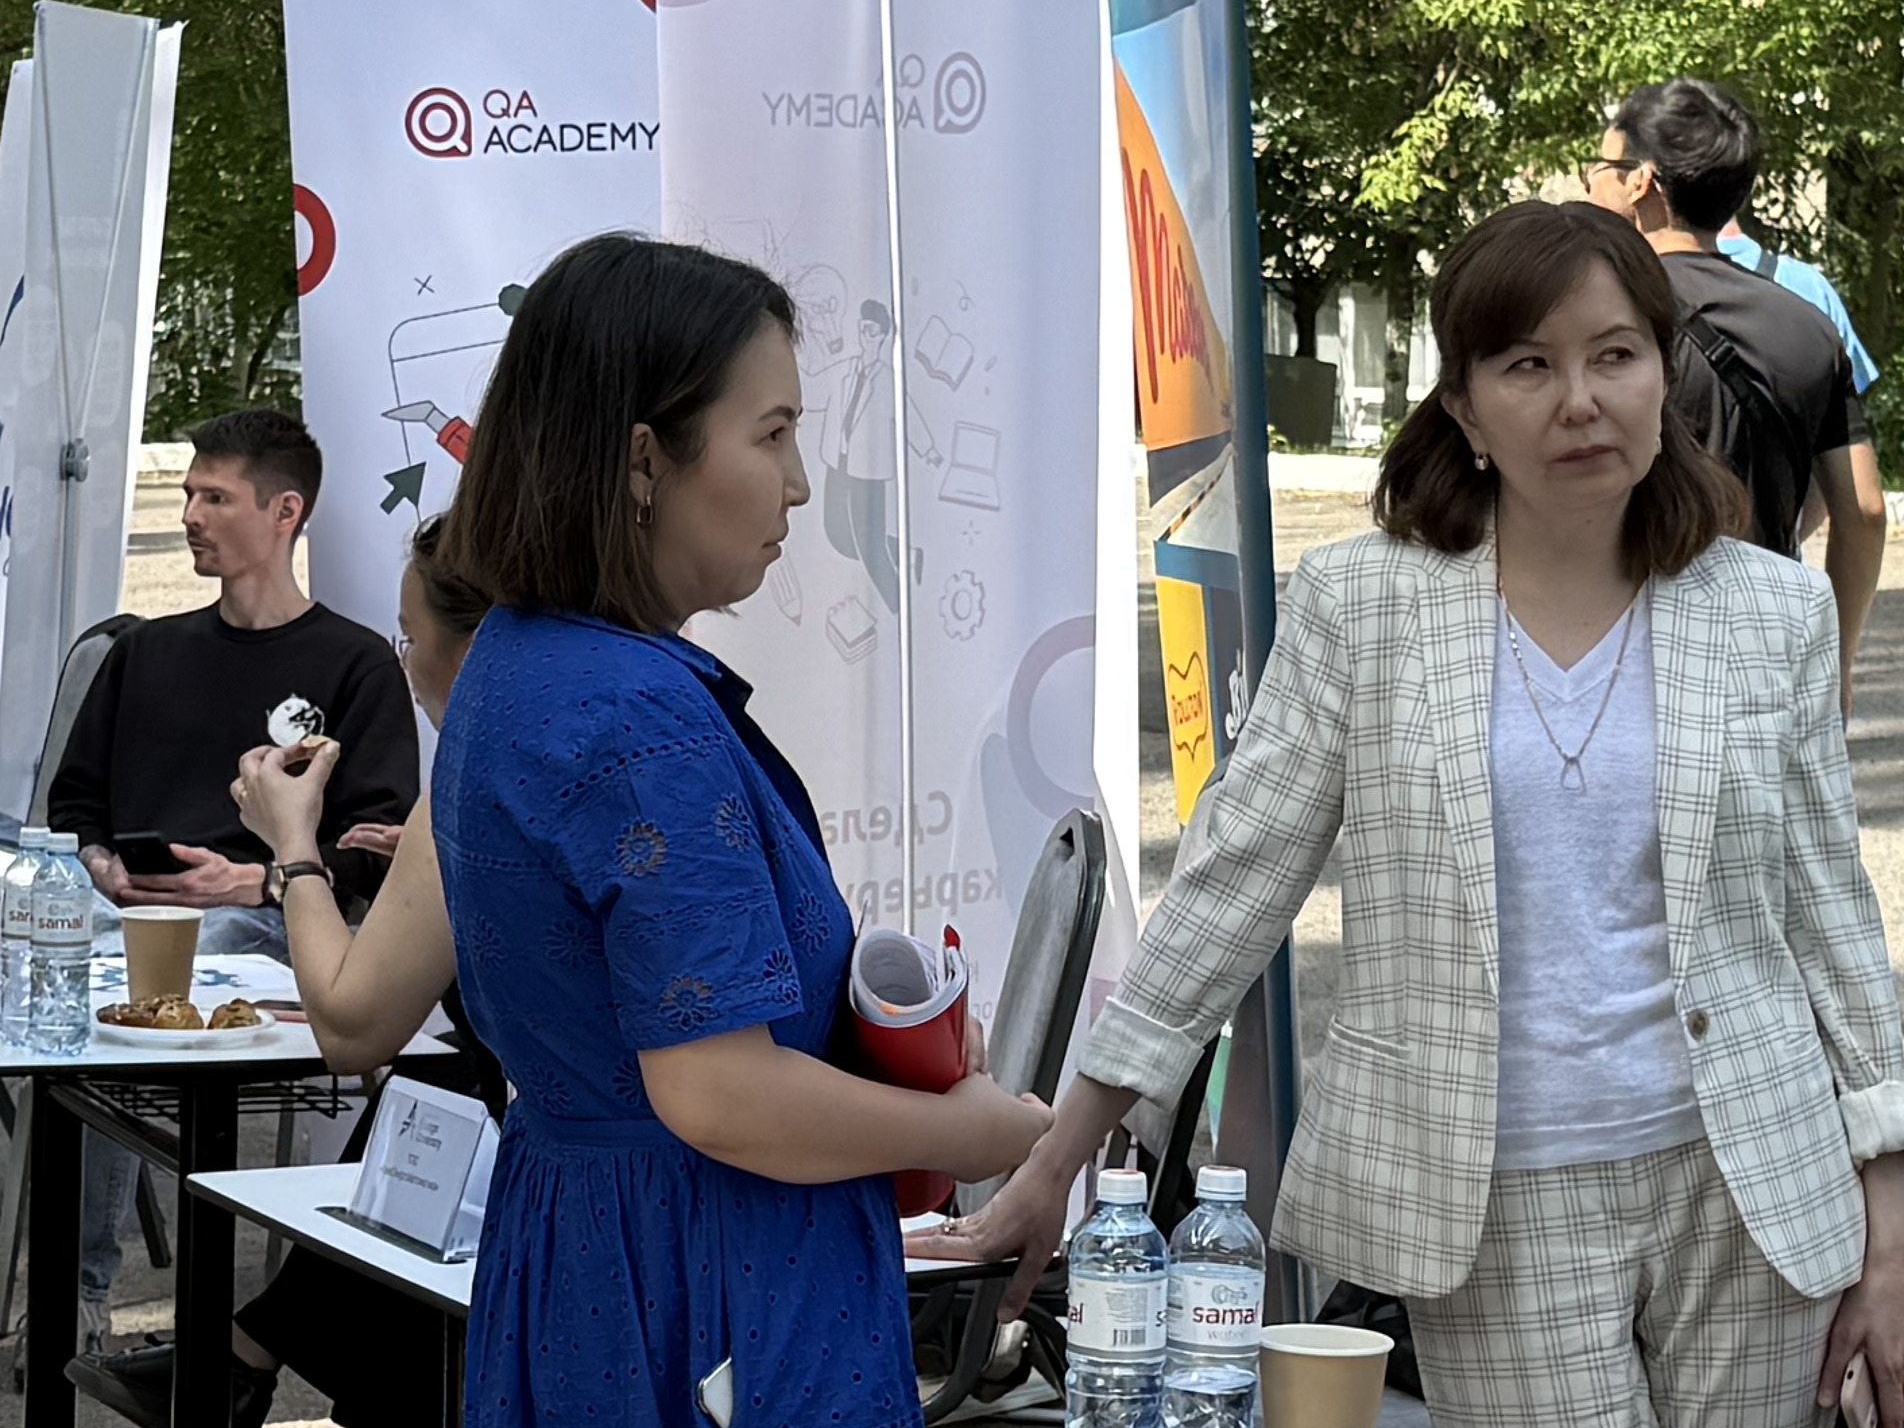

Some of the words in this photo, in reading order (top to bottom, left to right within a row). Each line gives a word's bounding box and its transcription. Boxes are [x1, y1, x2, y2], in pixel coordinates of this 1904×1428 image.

[483, 89, 537, 119] QA
[483, 122, 660, 154] ACADEMY
[38, 914, 84, 930] samal
[1192, 1299, 1261, 1326] samal
